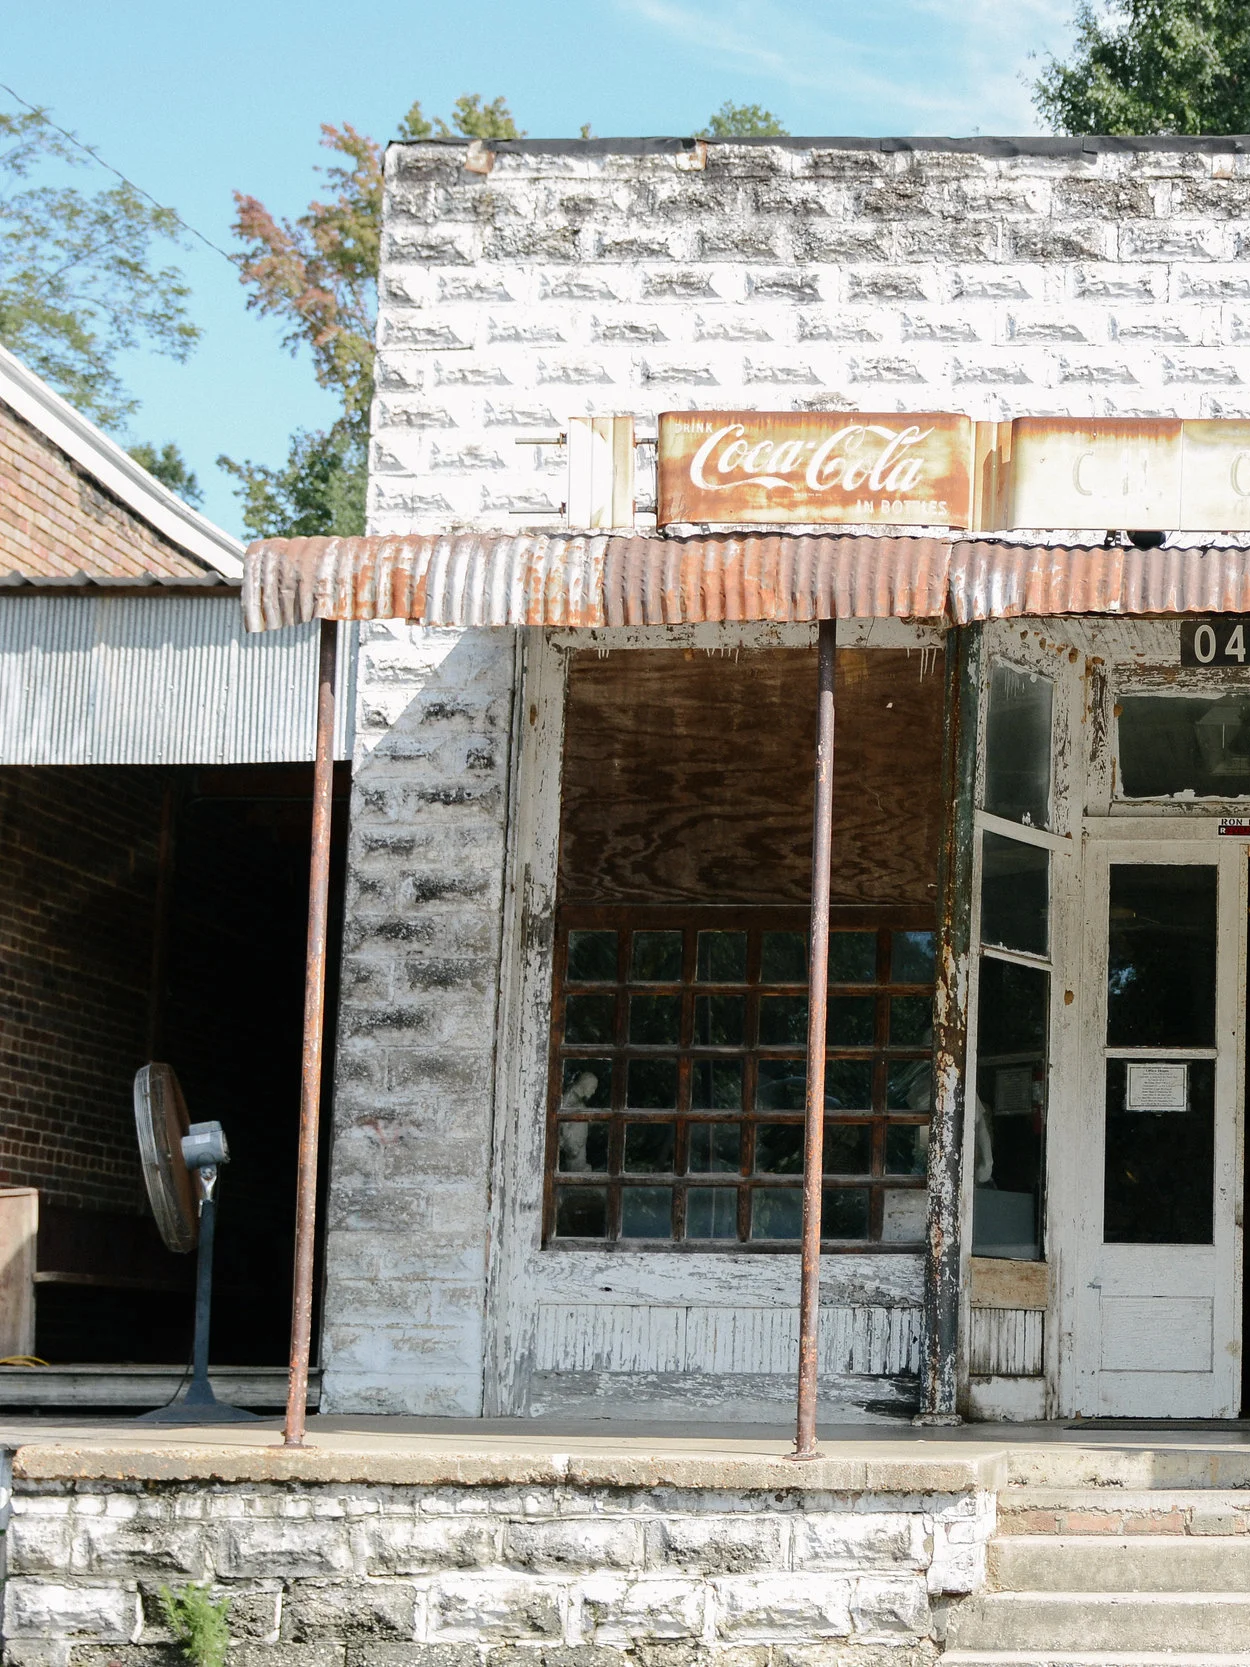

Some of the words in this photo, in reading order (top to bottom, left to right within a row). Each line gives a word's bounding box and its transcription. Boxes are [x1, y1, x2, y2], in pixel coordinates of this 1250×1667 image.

[674, 423, 713, 433] DRINK
[690, 424, 934, 491] Coca-Cola
[857, 500, 874, 513] IN
[1194, 624, 1246, 663] 04
[1221, 818, 1243, 826] RON
